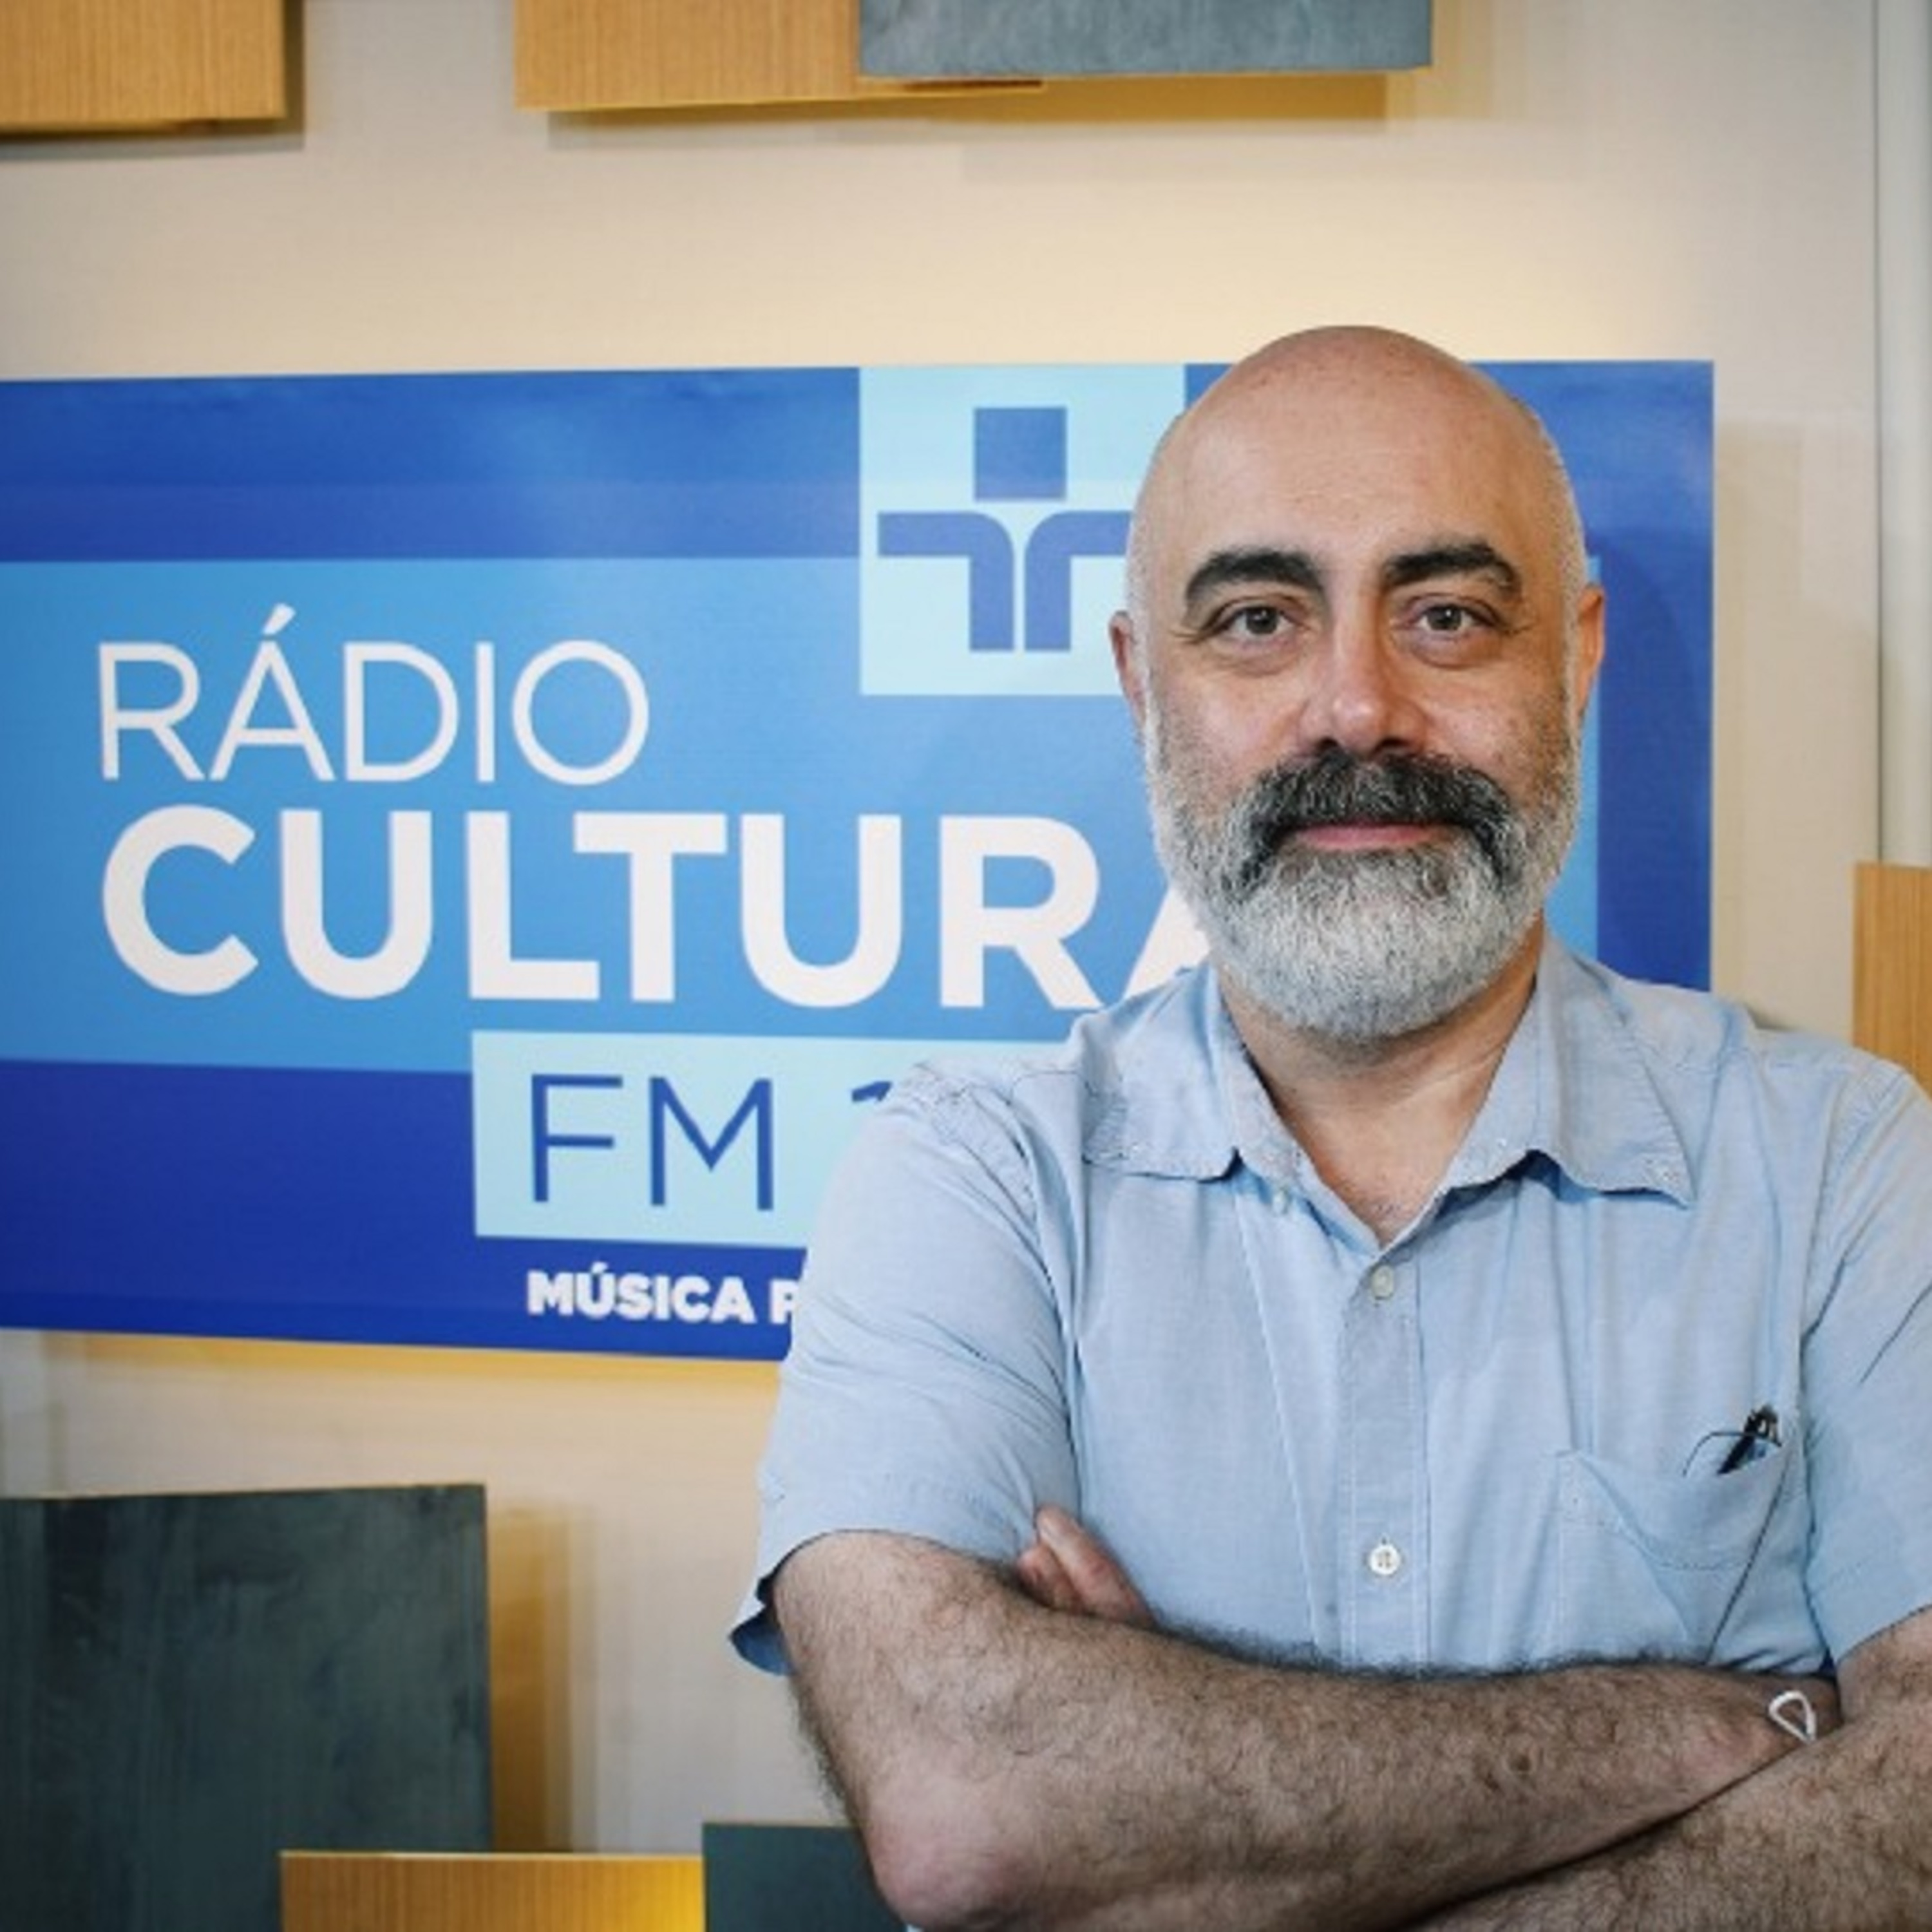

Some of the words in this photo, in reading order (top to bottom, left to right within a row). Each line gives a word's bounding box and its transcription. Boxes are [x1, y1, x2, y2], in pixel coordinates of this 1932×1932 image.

[99, 603, 649, 785] RÁDIO
[531, 1074, 773, 1211] FM
[527, 1262, 756, 1325] MÚSICA
